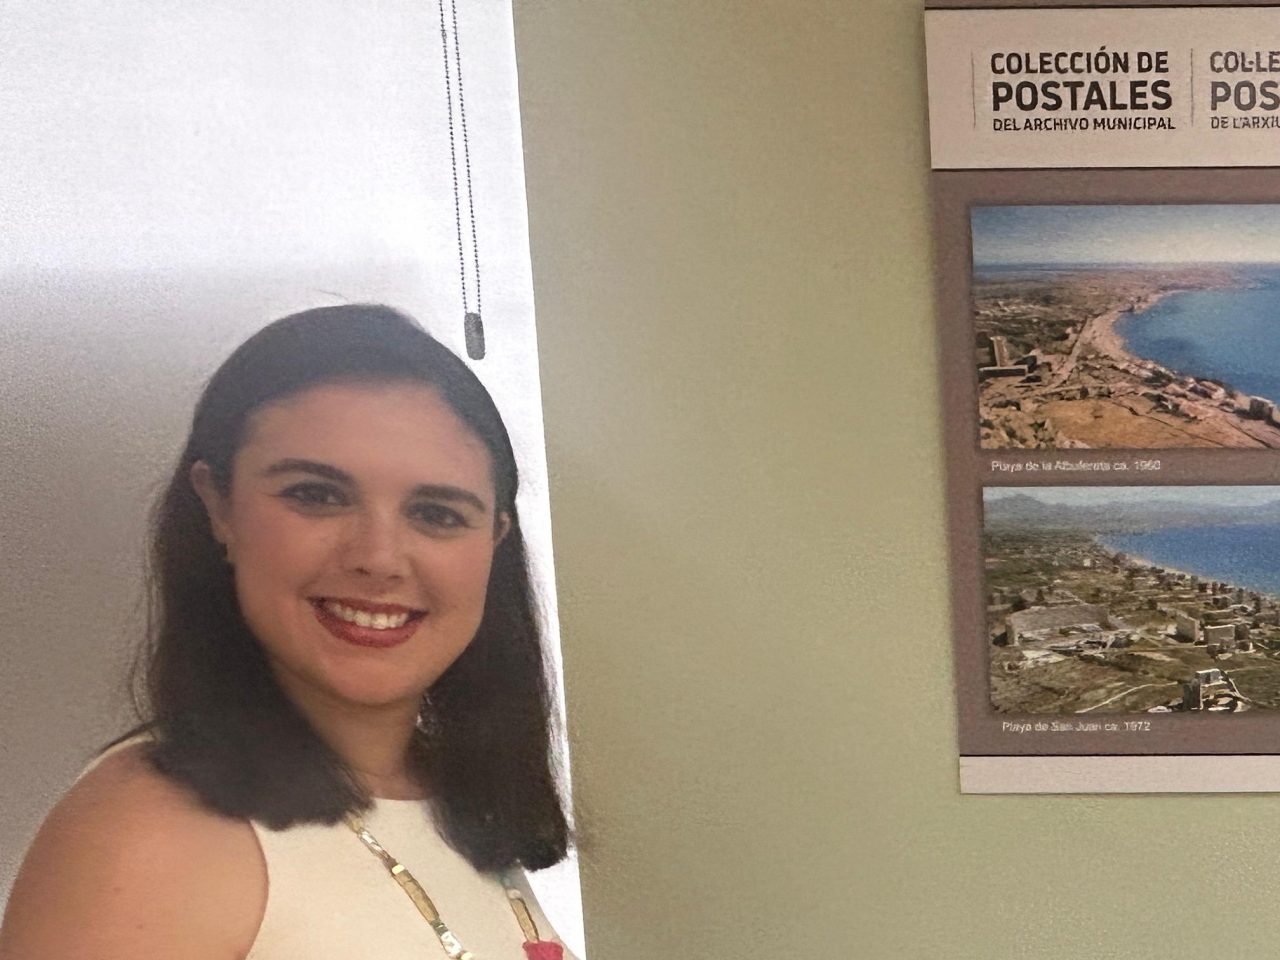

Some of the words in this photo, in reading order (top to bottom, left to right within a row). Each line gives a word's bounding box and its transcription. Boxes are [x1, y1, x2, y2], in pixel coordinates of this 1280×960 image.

[991, 46, 1129, 74] COLECCIÓN
[1137, 51, 1169, 73] DE
[992, 80, 1172, 111] POSTALES
[993, 118, 1021, 131] DEL
[1023, 117, 1089, 131] ARCHIVO
[1093, 117, 1176, 130] MUNICIPAL
[1211, 116, 1229, 129] DE
